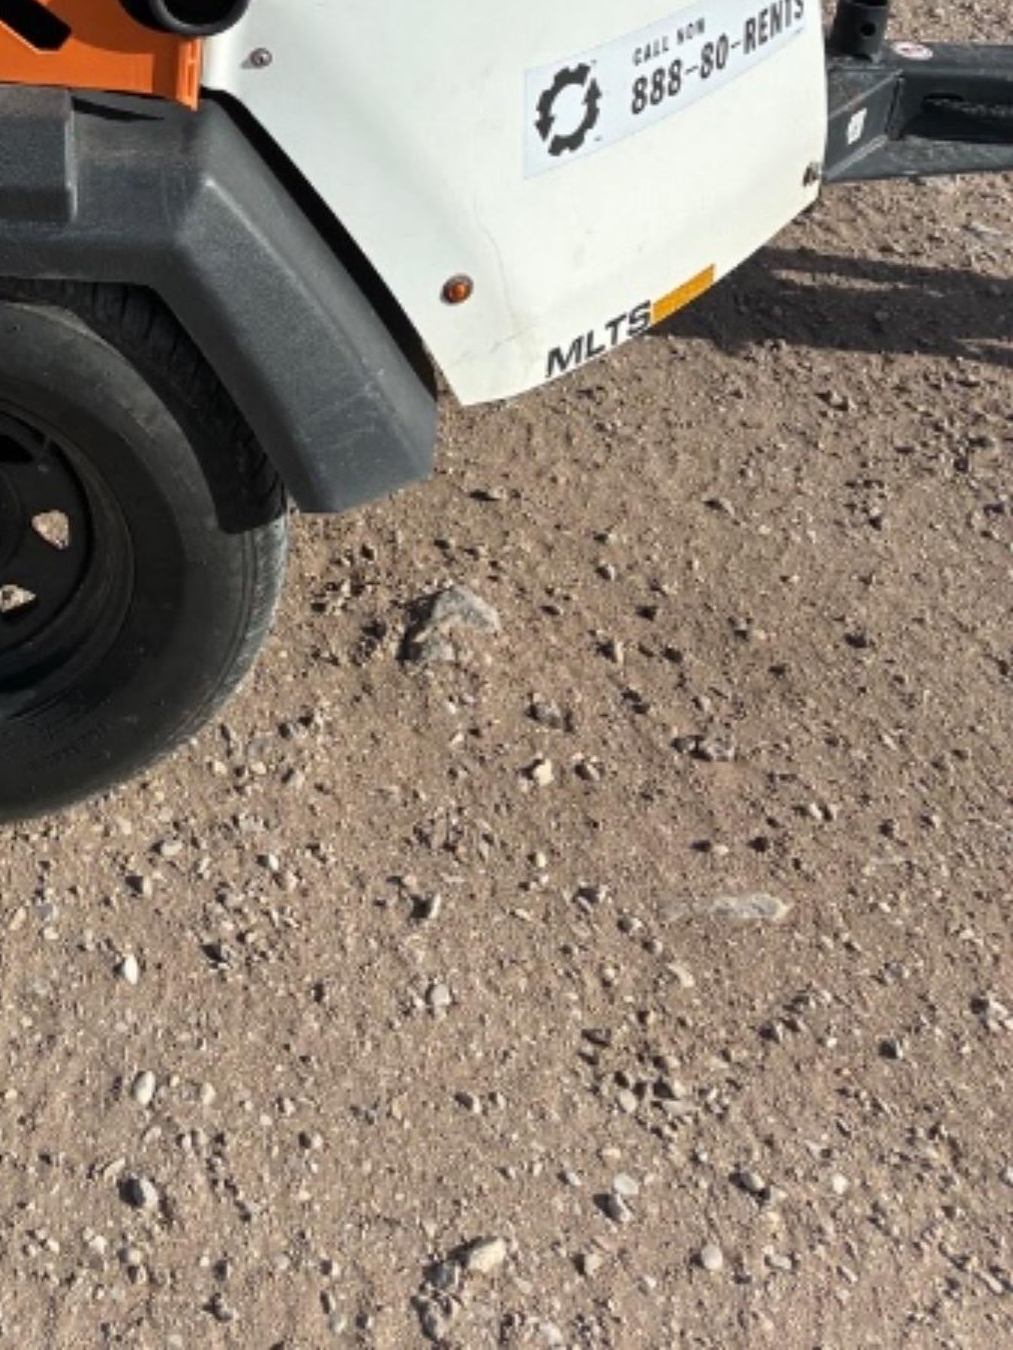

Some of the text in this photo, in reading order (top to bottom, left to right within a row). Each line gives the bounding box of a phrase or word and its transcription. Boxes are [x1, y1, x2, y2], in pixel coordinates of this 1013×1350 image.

[632, 17, 706, 67] CALL NOW
[544, 299, 652, 378] MLTS
